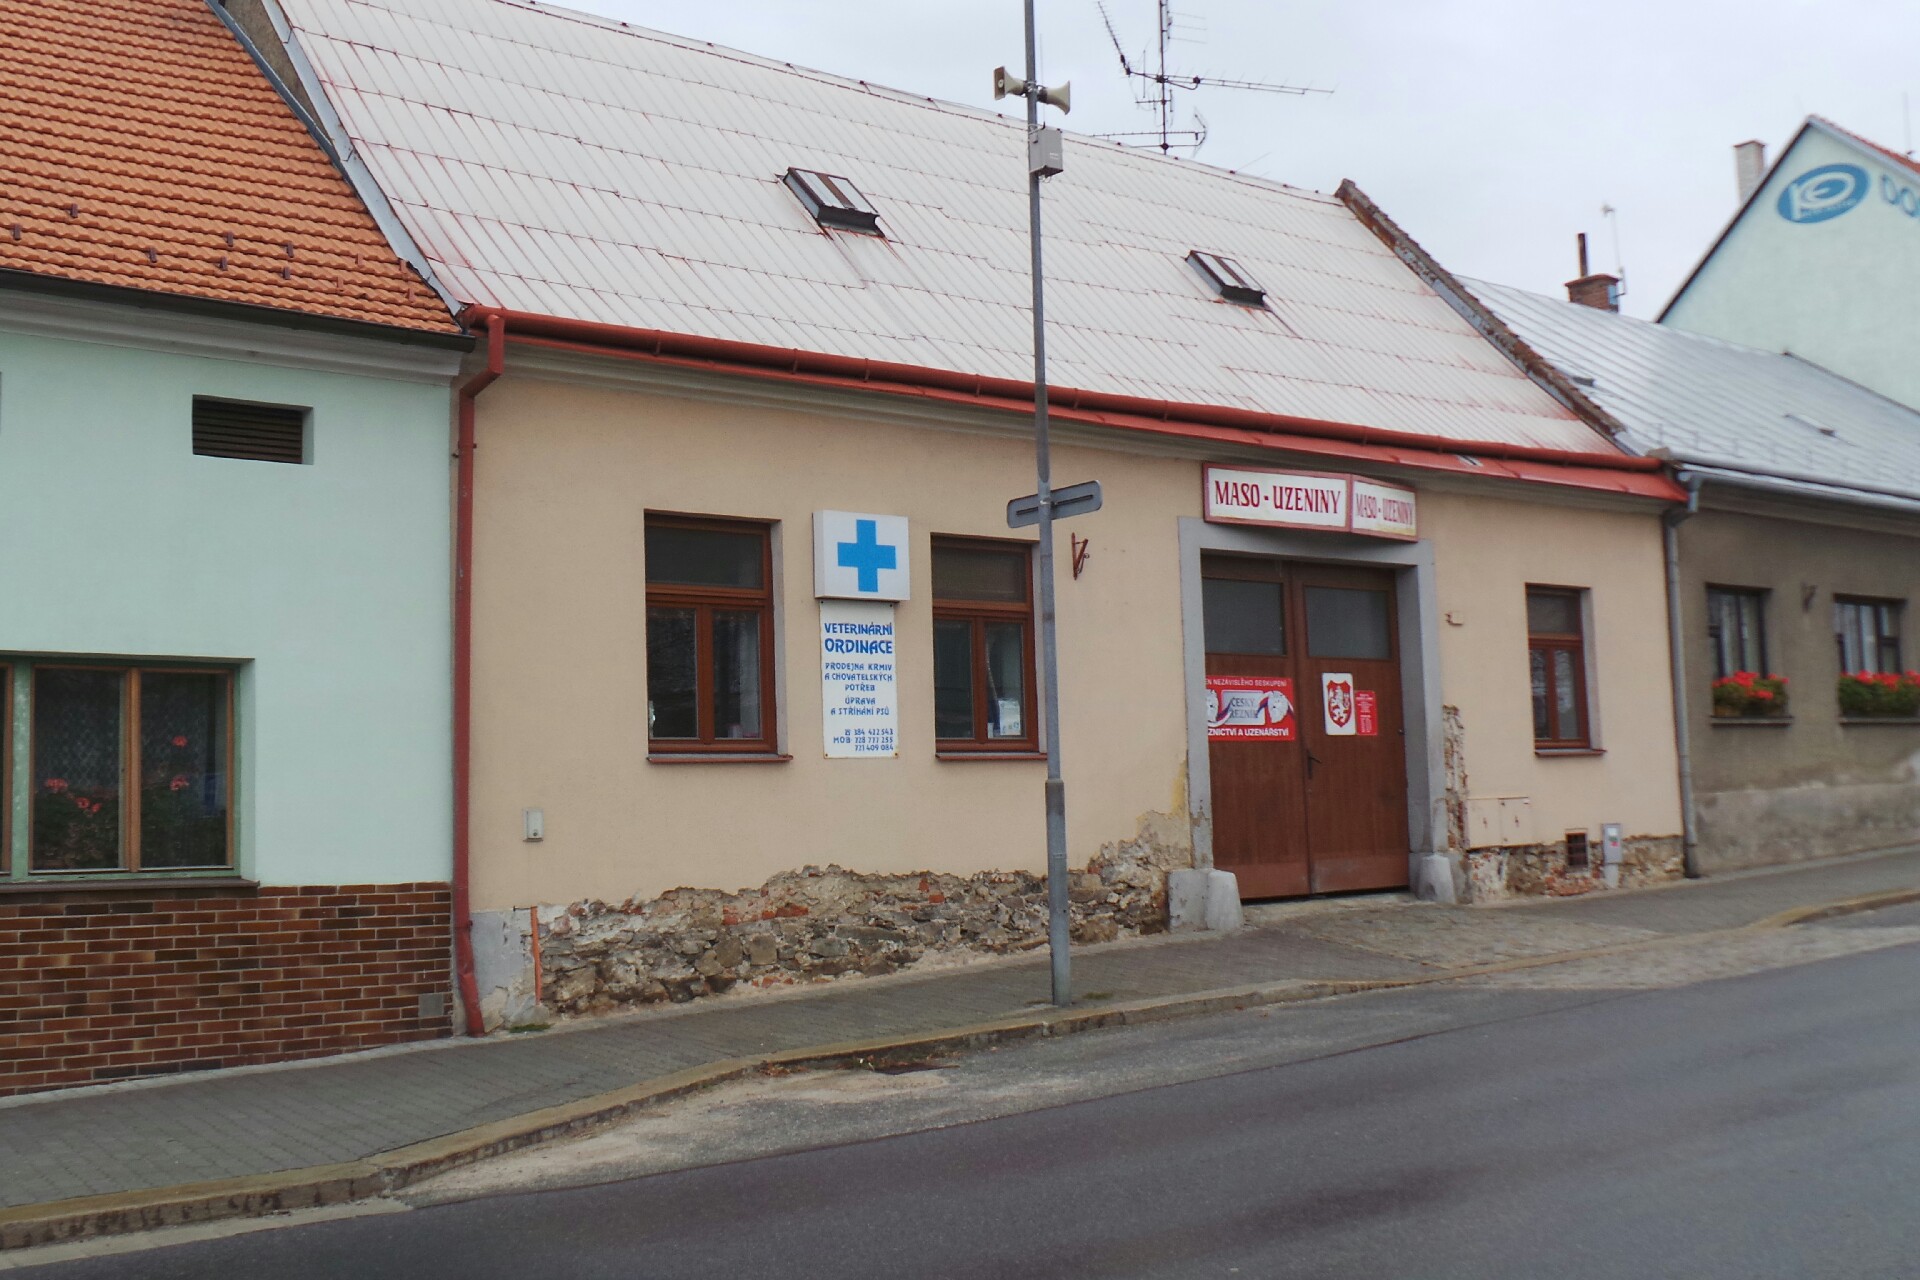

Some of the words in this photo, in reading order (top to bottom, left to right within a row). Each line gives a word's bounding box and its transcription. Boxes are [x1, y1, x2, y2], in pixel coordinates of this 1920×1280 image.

[1214, 480, 1260, 508] MASO
[1272, 485, 1341, 514] UZENINY
[1355, 493, 1377, 519] MASO
[1383, 498, 1413, 525] UZENINY
[824, 621, 893, 635] VETERINÁRNÍ
[824, 638, 893, 655] ORDINACE
[825, 662, 864, 671] PRODEJNA
[868, 663, 892, 671] KRMIV
[831, 671, 893, 681] CHOVATELSKÝCH
[845, 682, 875, 691] POTŘEB
[845, 695, 876, 705] ÚPRAVA
[1238, 728, 1244, 736] A
